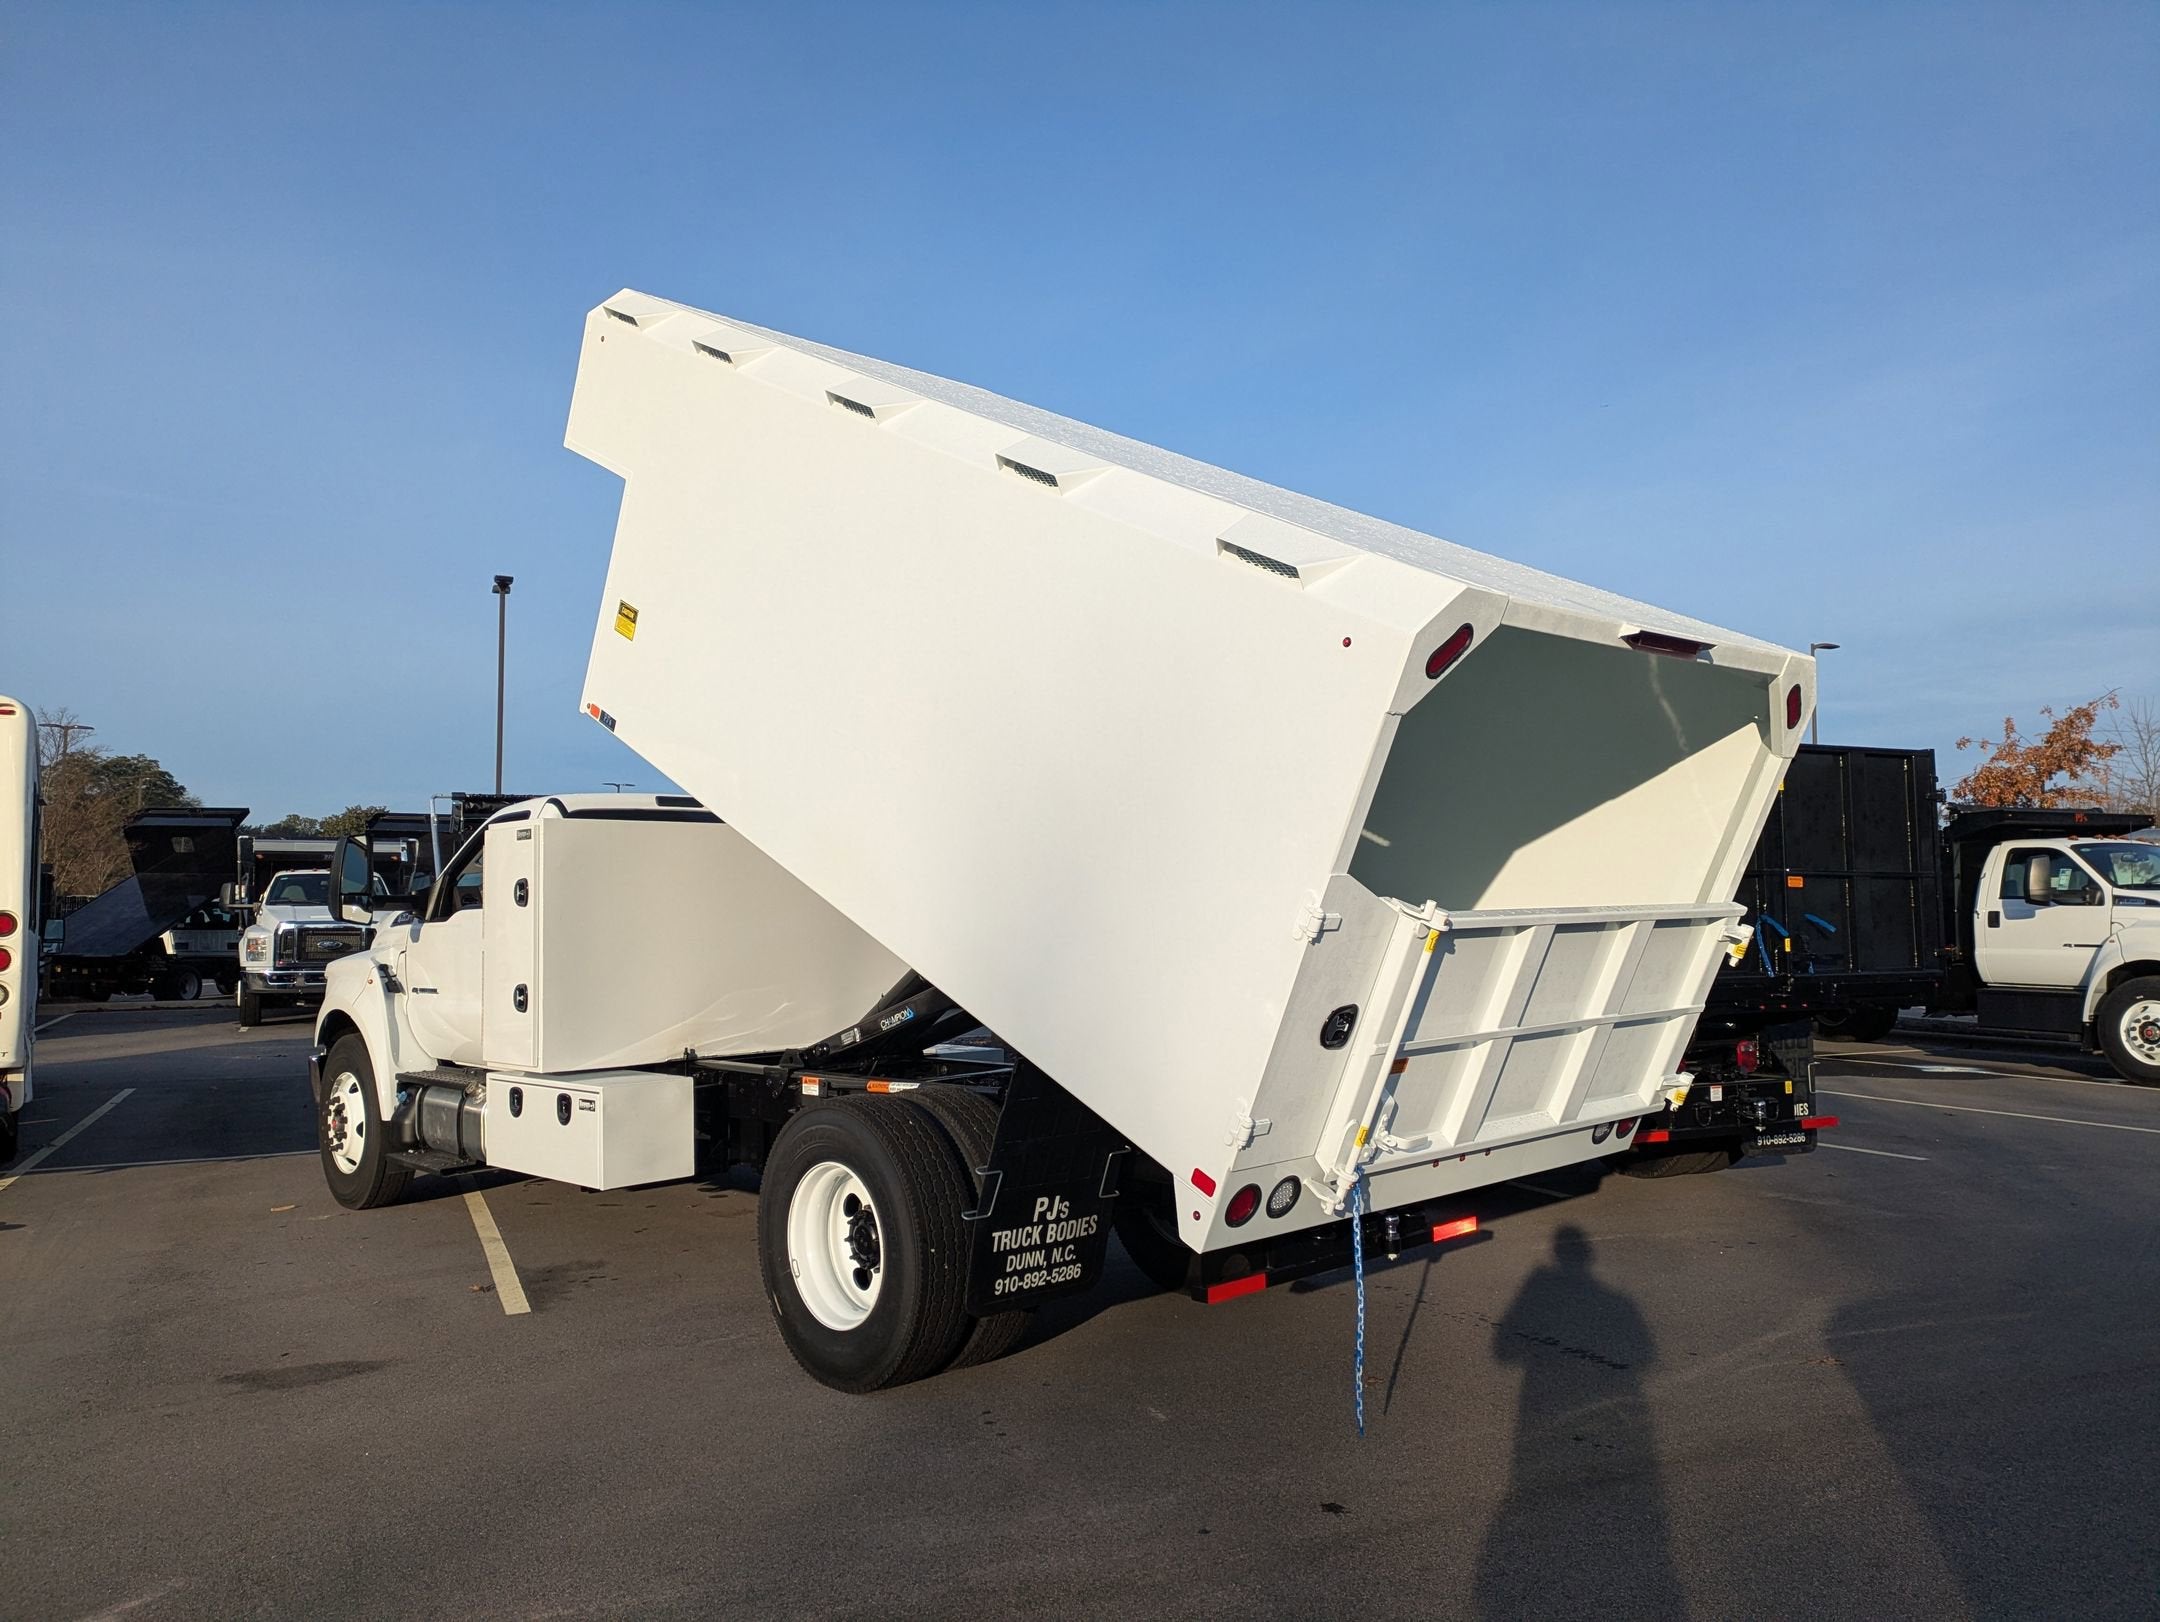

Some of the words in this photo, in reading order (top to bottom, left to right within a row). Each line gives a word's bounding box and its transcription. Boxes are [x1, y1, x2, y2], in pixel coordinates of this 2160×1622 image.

[1757, 1132, 1806, 1146] 910-892-5286
[1033, 1195, 1070, 1222] PJ's
[992, 1224, 1043, 1253] TRUCK
[1046, 1214, 1098, 1244] BODIES
[1006, 1249, 1047, 1273] DUNN,
[1051, 1244, 1077, 1264] N.C.
[994, 1263, 1082, 1296] 910-892-5286
